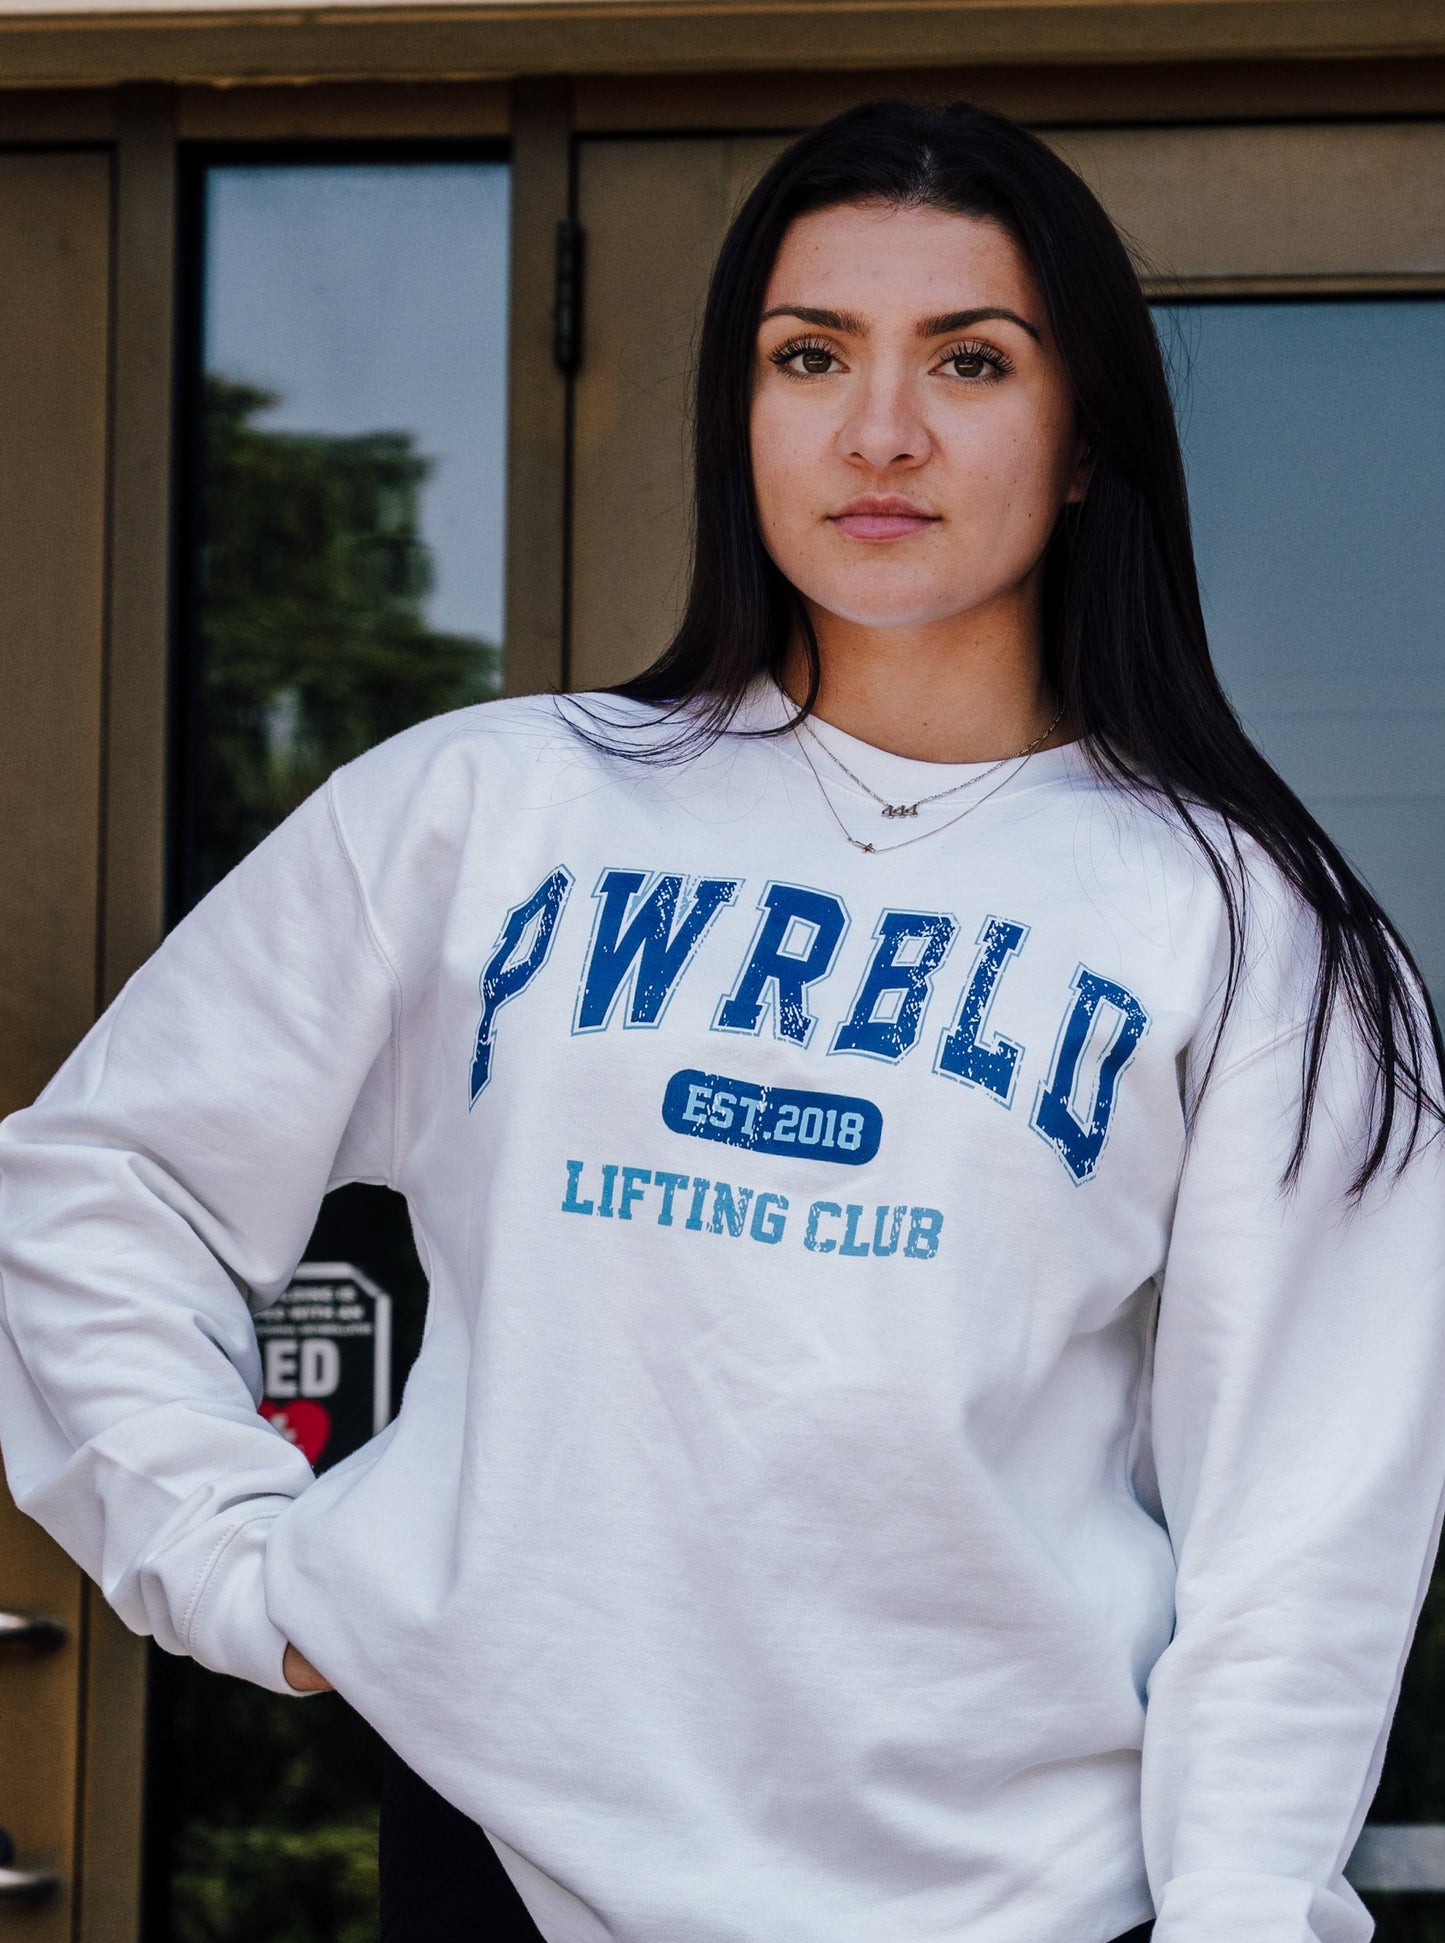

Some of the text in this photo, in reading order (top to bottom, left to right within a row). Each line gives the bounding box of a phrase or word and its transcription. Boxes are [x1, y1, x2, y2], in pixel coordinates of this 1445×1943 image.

[469, 864, 1151, 1186] PWRBLD
[561, 1159, 944, 1260] LIFTING CLUB
[264, 1338, 340, 1398] ED
